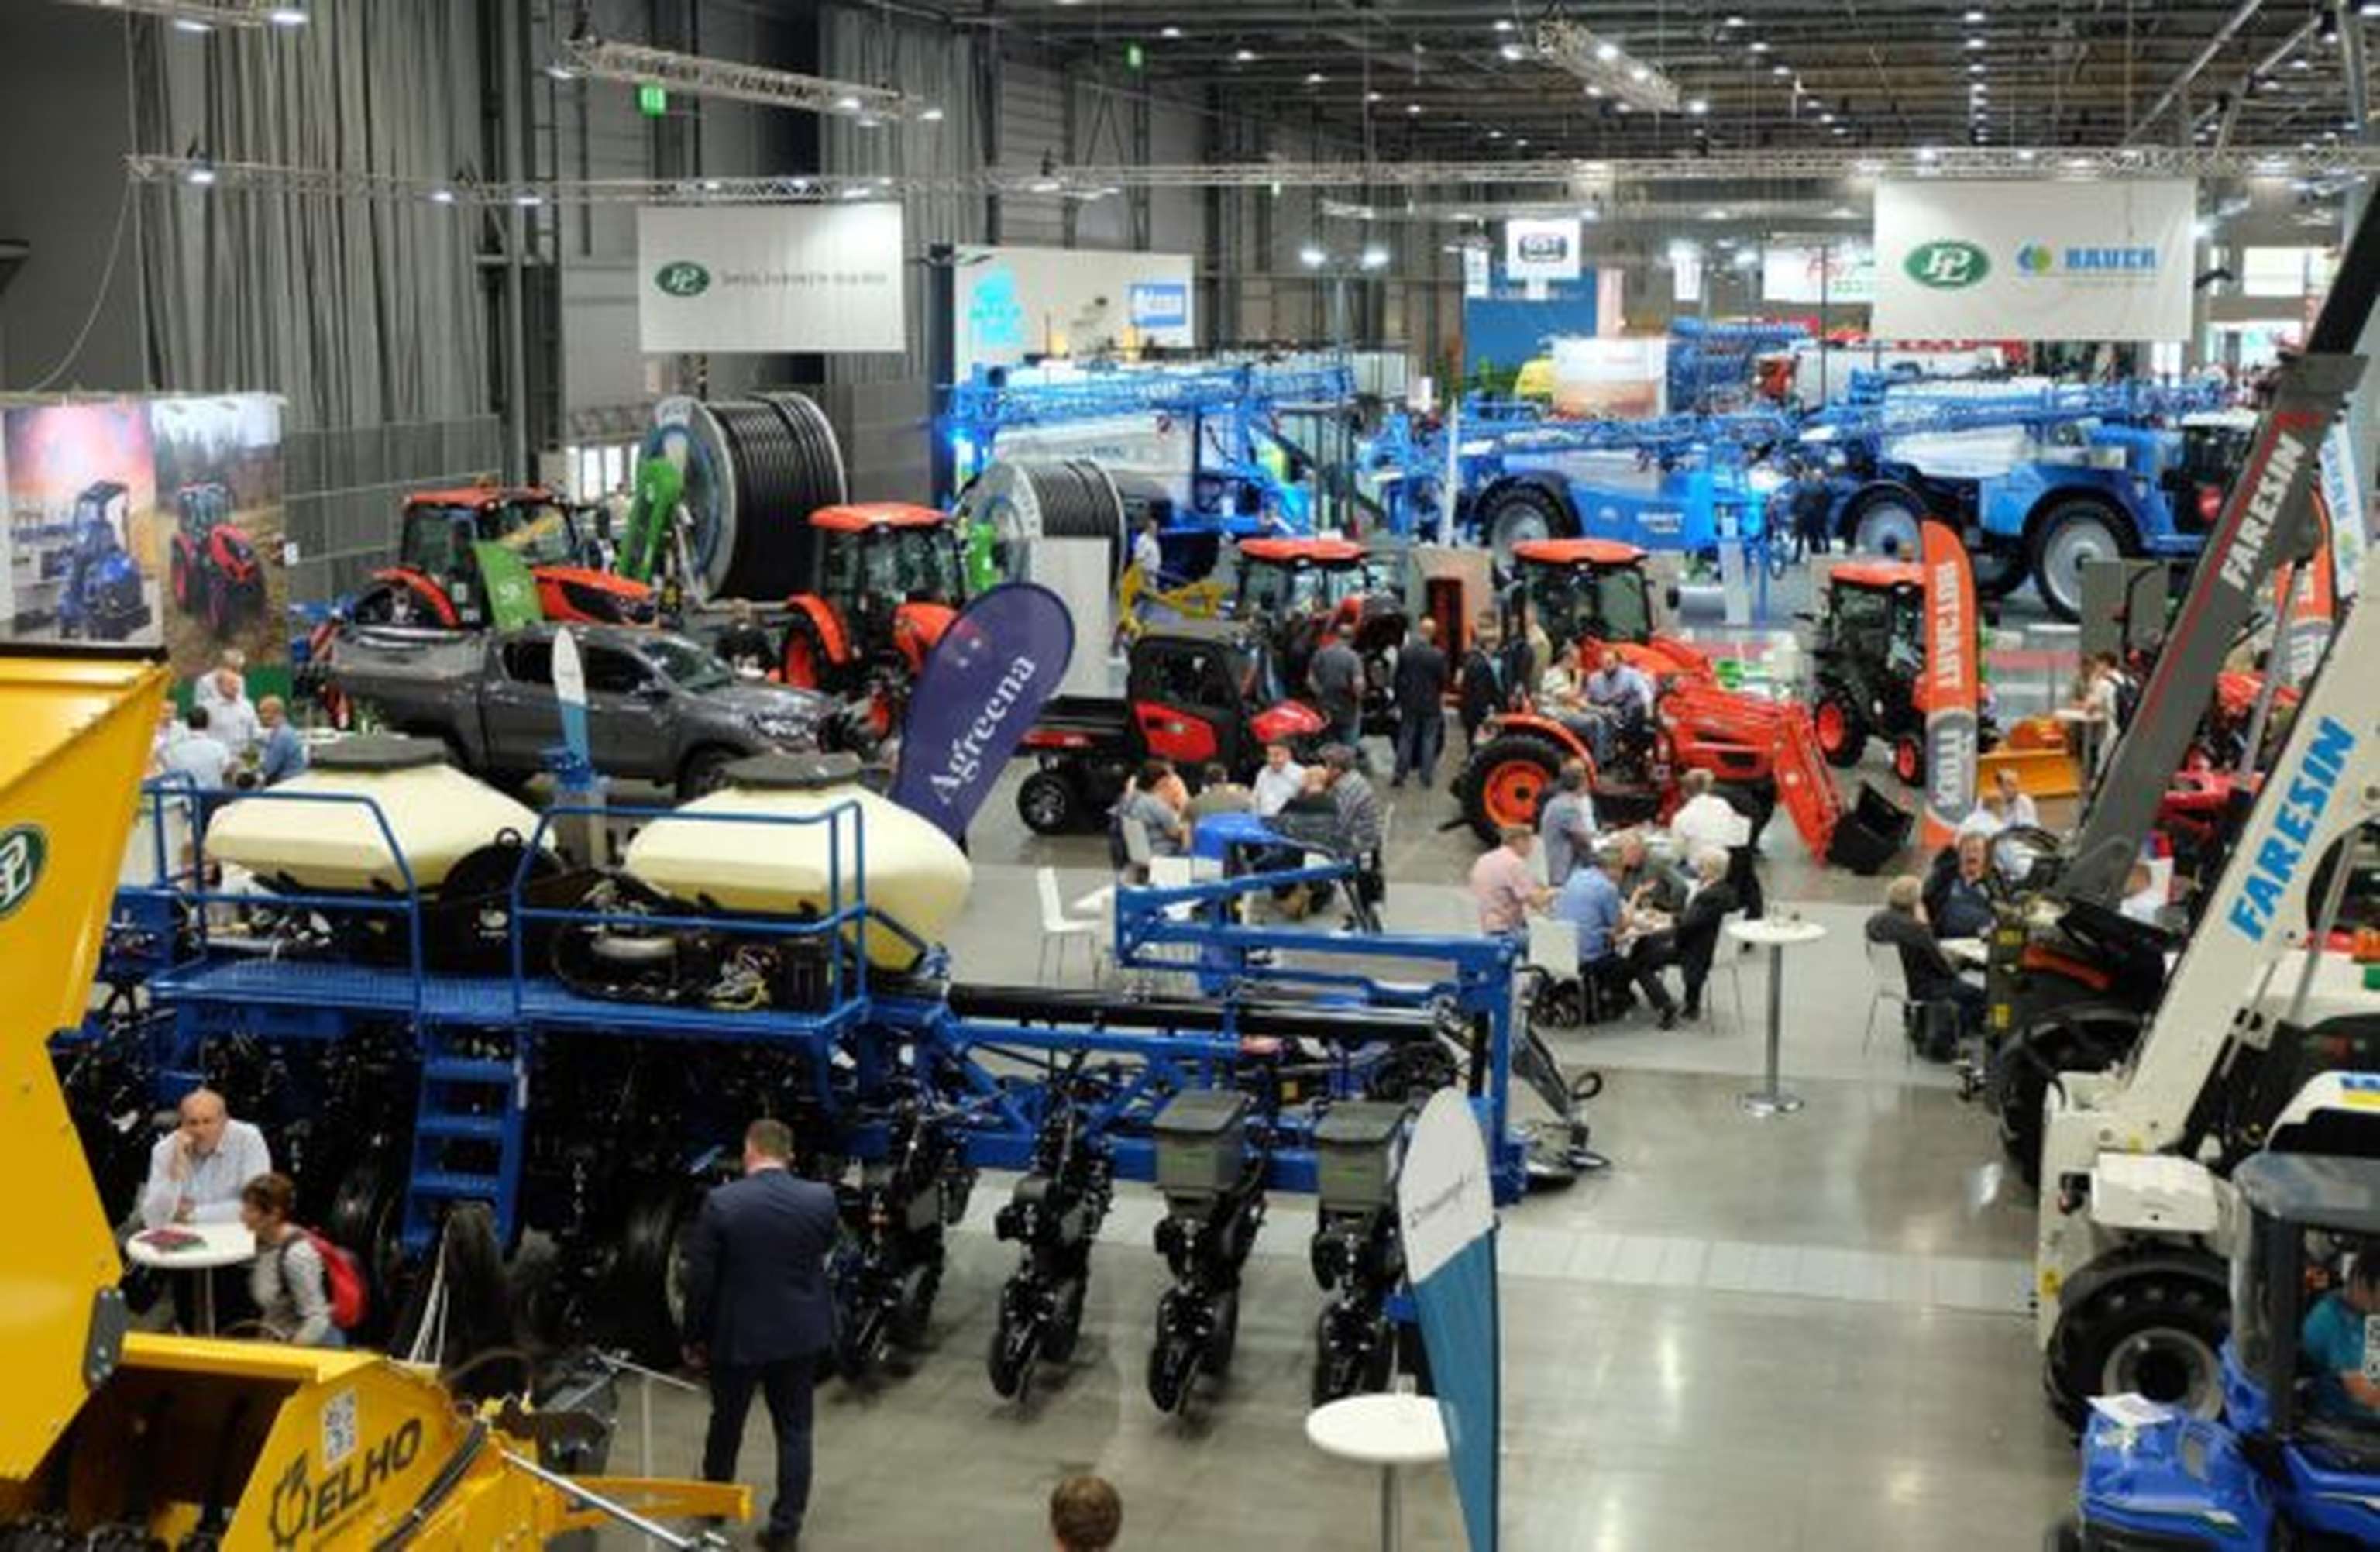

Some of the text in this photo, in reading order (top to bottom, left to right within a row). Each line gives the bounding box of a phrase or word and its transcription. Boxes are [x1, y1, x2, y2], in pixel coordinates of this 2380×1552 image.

[2220, 432, 2306, 592] FARESIN
[930, 655, 1037, 805] Agreena
[2228, 714, 2355, 941] FARESIN
[311, 1417, 423, 1529] ELHO
